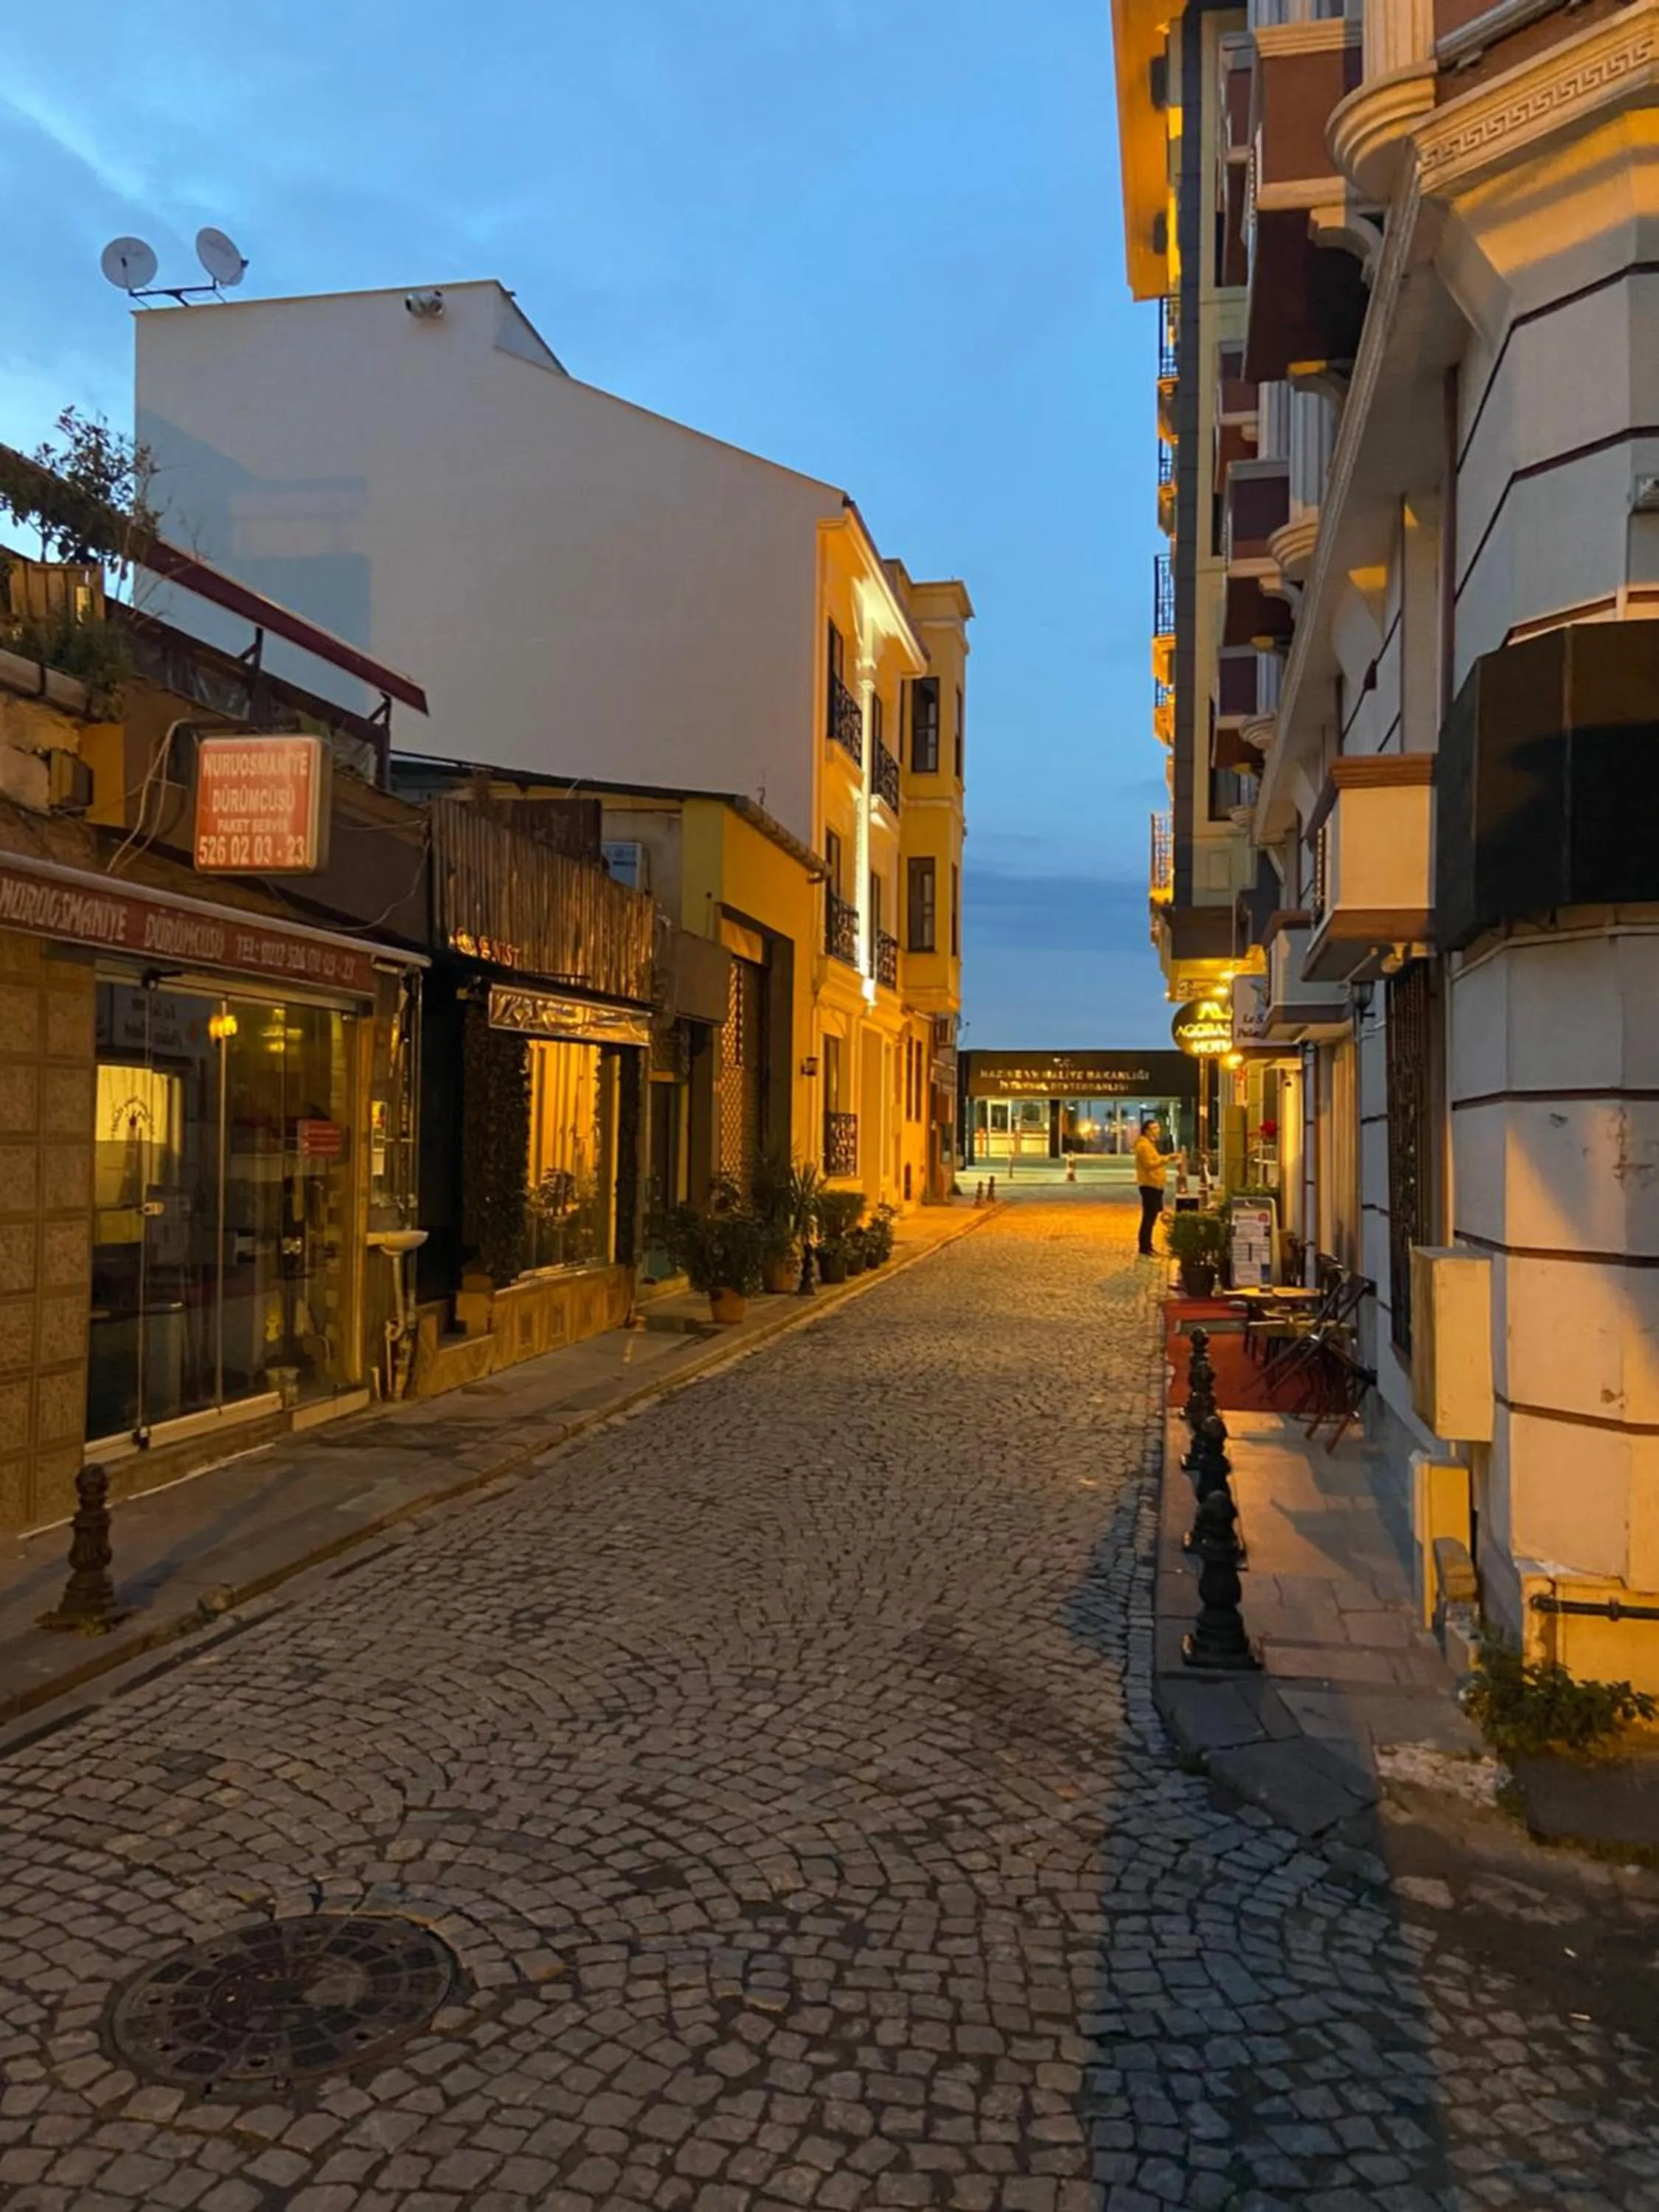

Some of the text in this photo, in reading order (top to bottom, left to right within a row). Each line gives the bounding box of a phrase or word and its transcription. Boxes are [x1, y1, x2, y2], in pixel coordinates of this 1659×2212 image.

[198, 835, 226, 865] 526
[231, 835, 250, 865] 02
[254, 835, 273, 865] 03
[286, 835, 306, 865] 23
